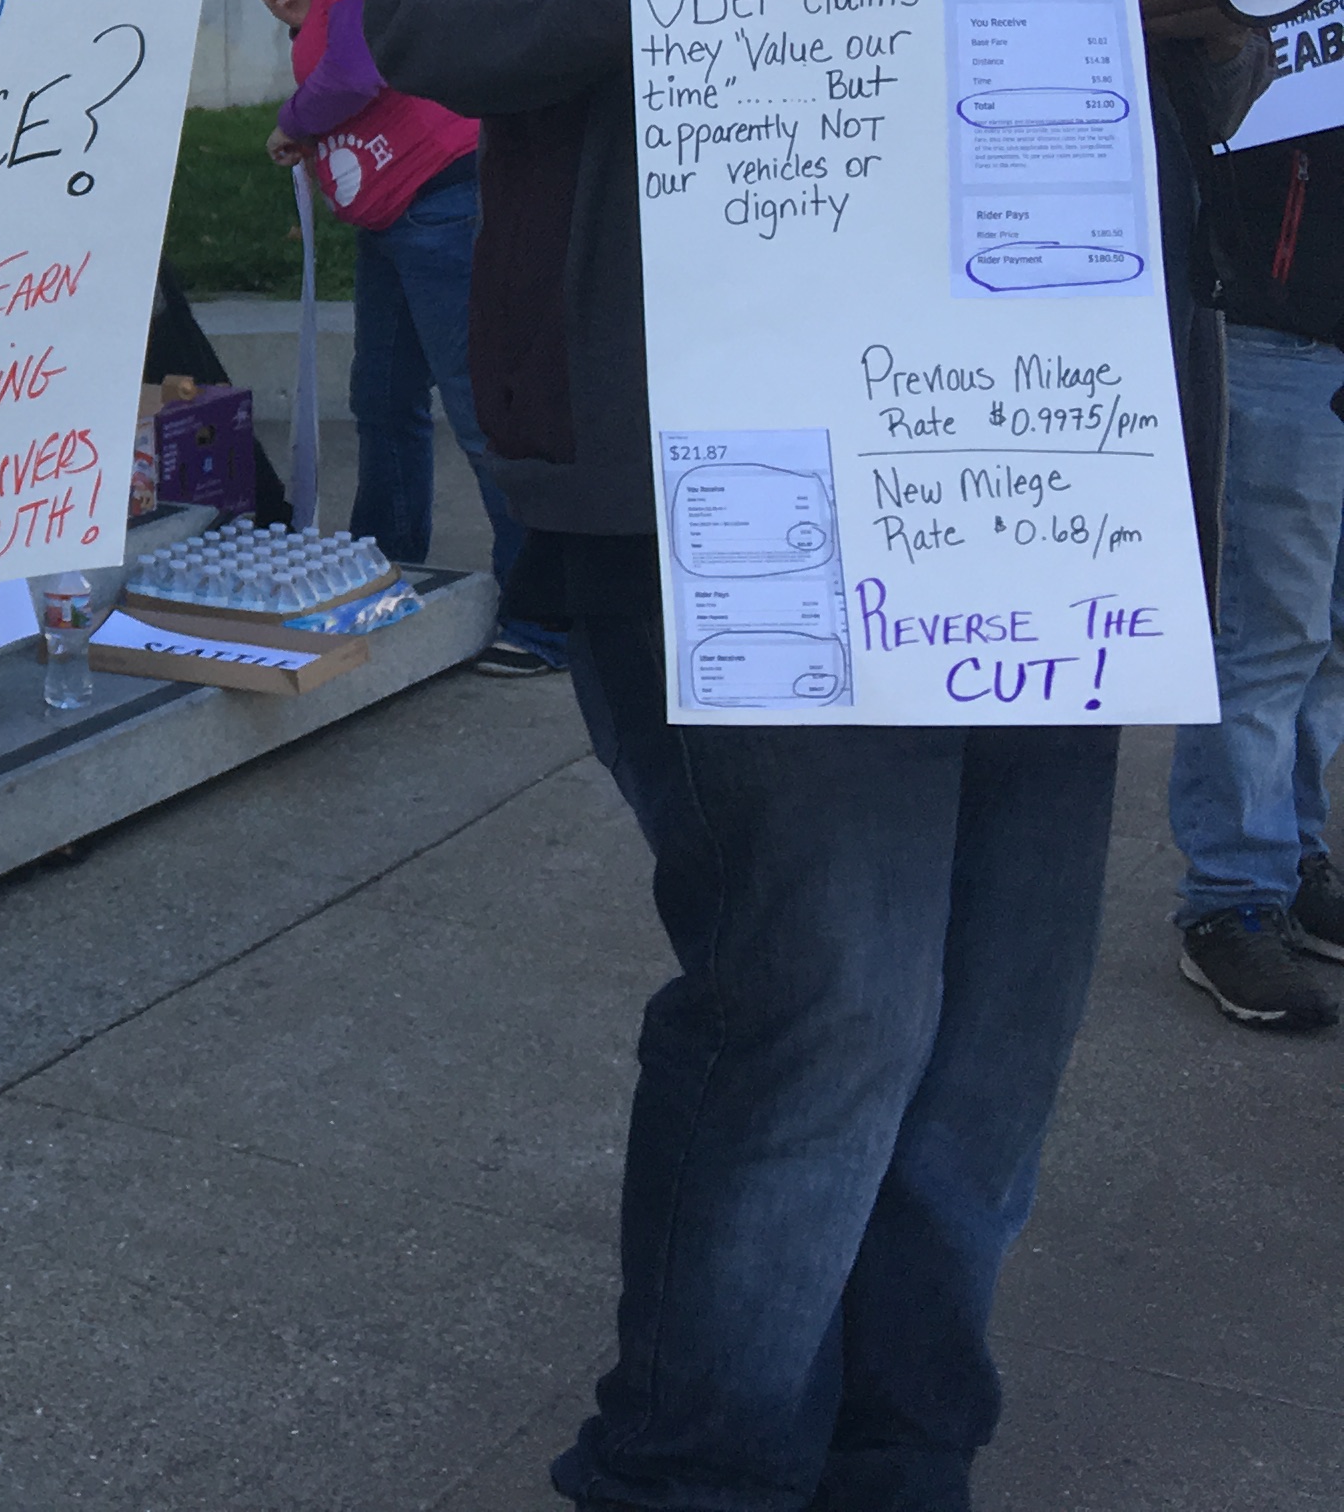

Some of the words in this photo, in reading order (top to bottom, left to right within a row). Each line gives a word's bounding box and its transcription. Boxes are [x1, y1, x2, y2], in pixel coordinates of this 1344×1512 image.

[970, 18, 989, 28] You
[991, 18, 1027, 28] Receive
[641, 35, 723, 83] they
[846, 30, 912, 58] our
[826, 65, 898, 100] But
[974, 102, 995, 111] Total
[645, 113, 799, 165] apparently
[821, 108, 885, 141] NOT
[646, 169, 697, 199] our
[726, 152, 829, 185] vehicles
[845, 154, 883, 178] or
[724, 183, 850, 241] dignity
[977, 210, 1002, 220] Rider
[1006, 210, 1030, 221] Pays
[861, 344, 995, 399] Previous
[879, 405, 957, 440] Rate
[669, 445, 728, 461] $21.87
[873, 467, 942, 508] New
[873, 516, 966, 564] Rate
[855, 576, 1039, 653] REVERSE
[1069, 594, 1164, 639] THE
[947, 647, 1107, 711] CUT!
